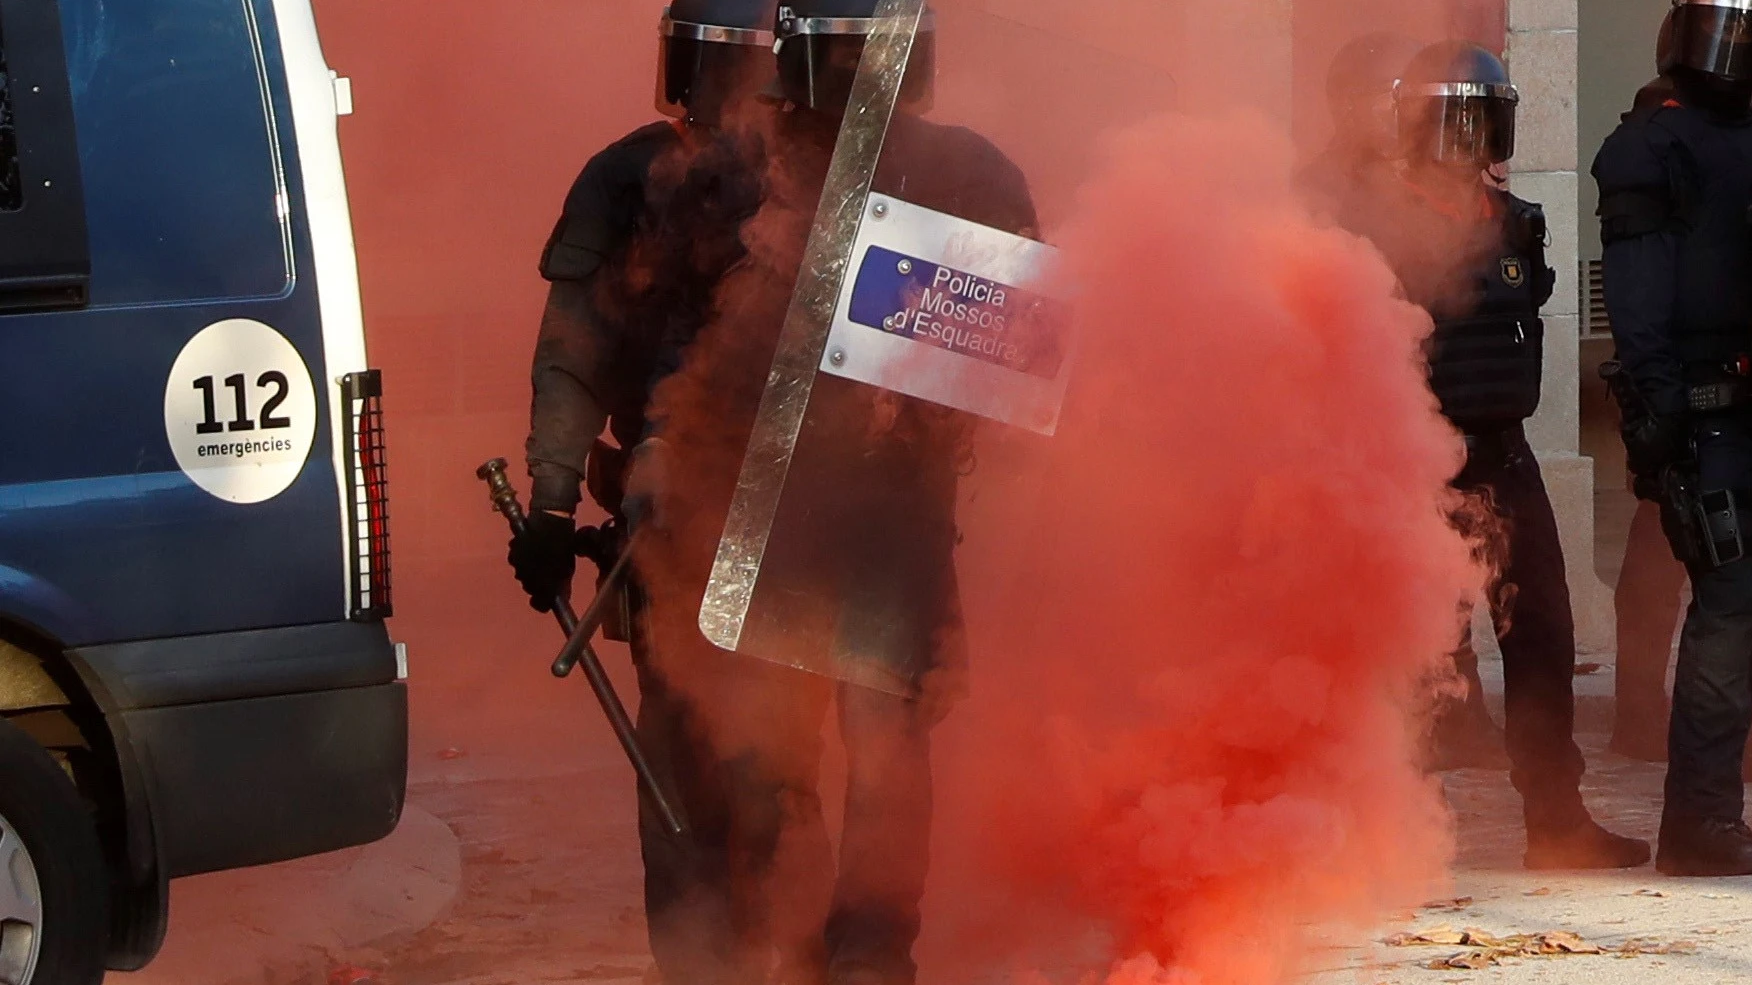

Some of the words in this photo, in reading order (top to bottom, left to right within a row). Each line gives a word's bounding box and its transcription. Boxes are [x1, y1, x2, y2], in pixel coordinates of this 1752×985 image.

[932, 266, 1006, 308] Policia
[920, 288, 1006, 332] Mossos
[894, 307, 1019, 362] d'Esquadra
[193, 370, 291, 434] 112
[198, 436, 292, 458] emergències
